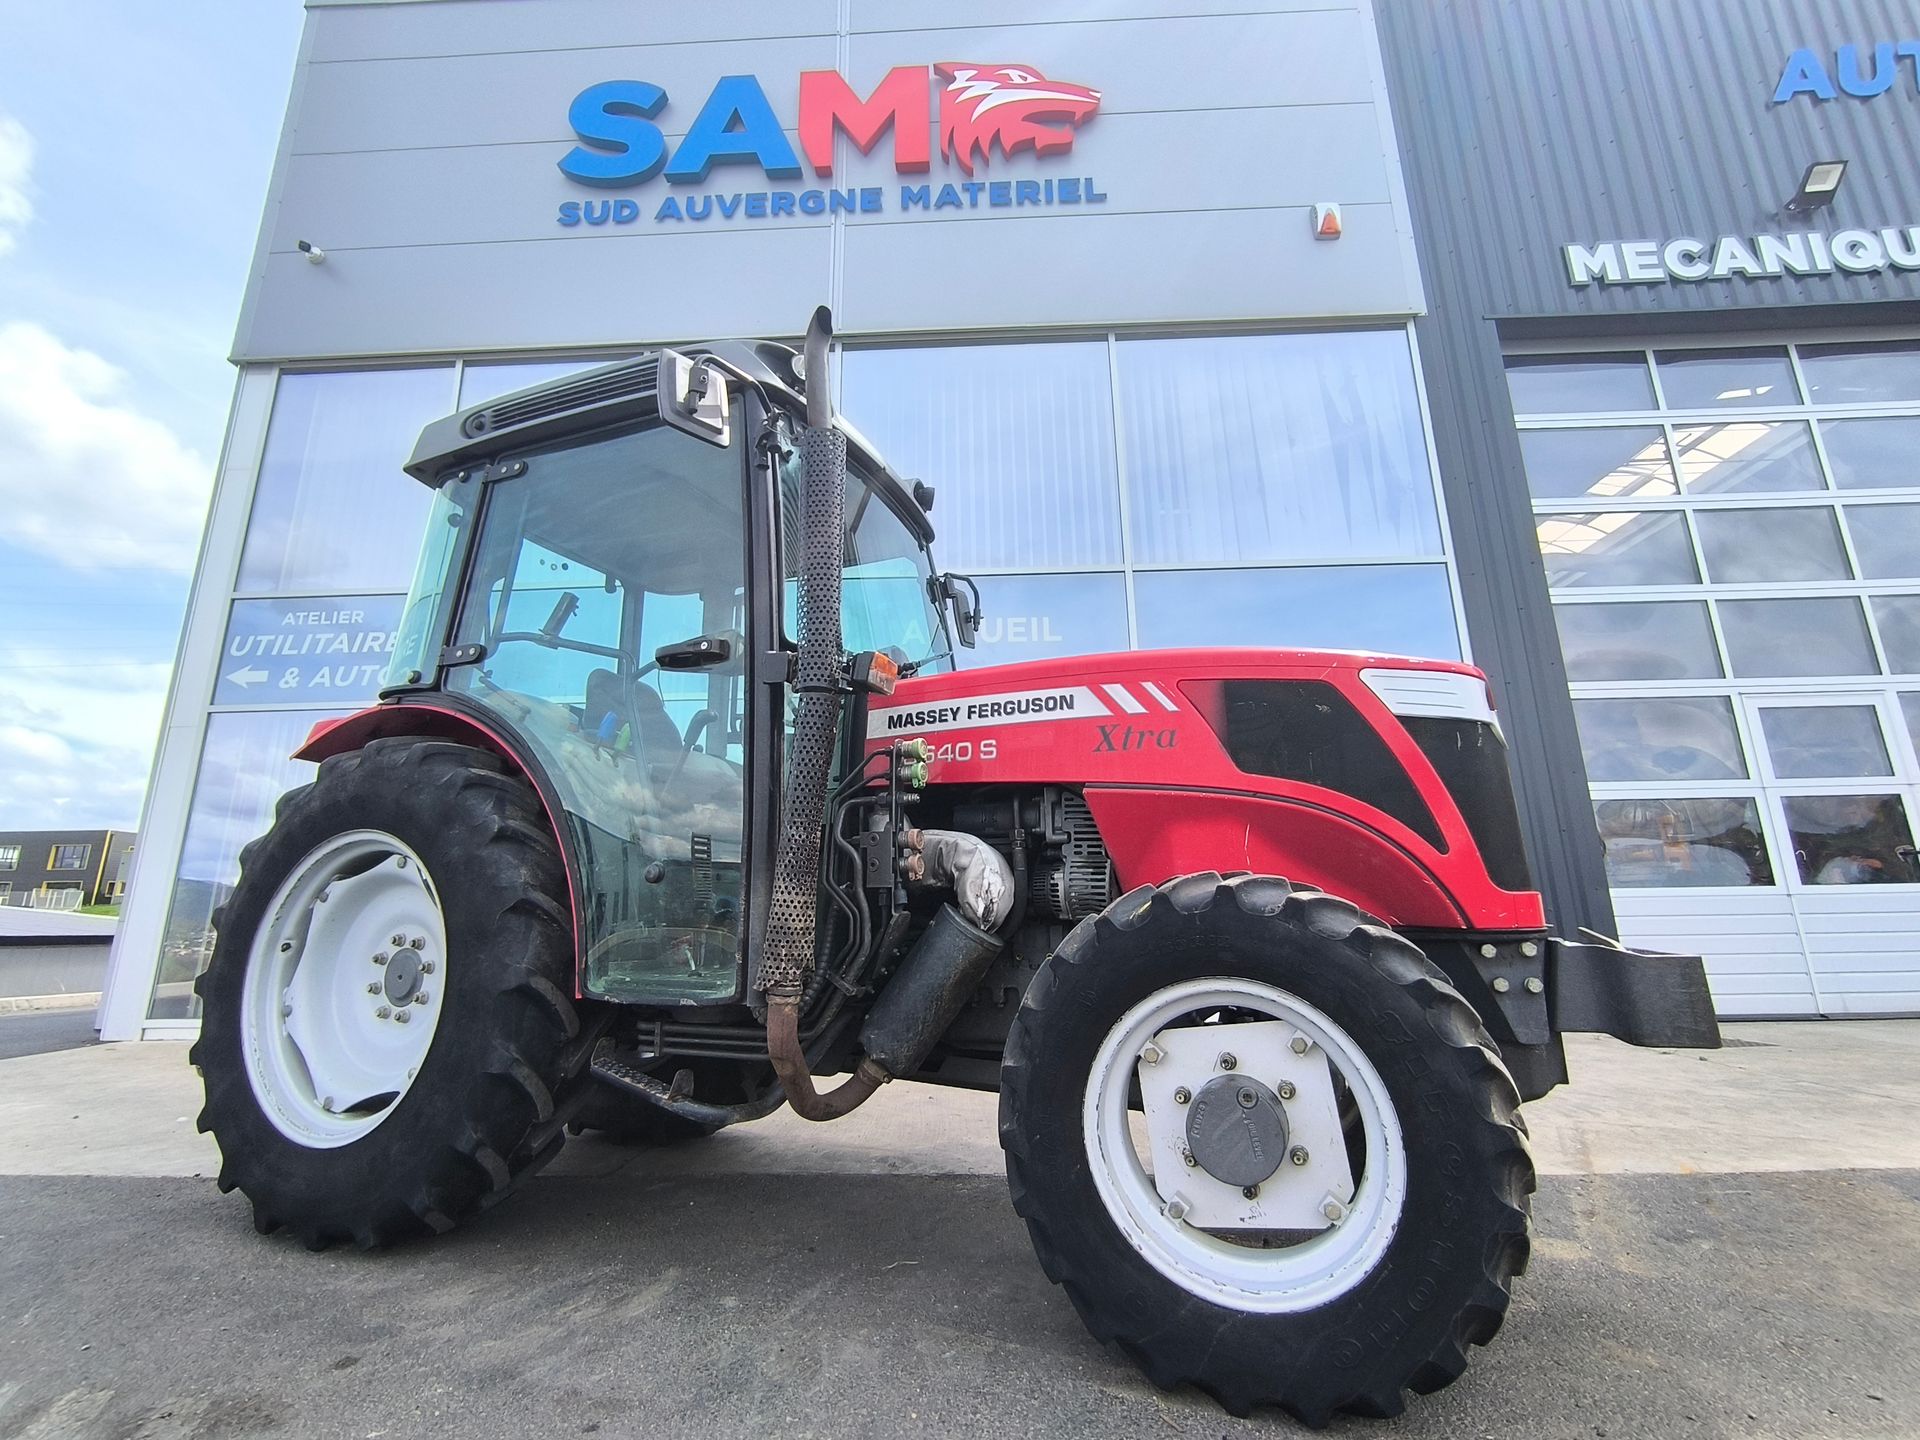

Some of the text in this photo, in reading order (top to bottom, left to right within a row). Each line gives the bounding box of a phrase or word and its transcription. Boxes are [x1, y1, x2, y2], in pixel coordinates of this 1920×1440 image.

[557, 65, 930, 188] SAM
[557, 177, 1108, 226] SUD AUVERGNE MATERIEL
[1564, 227, 1920, 284] MECANIQU
[281, 611, 364, 626] ATELIER
[902, 617, 1064, 645] AUEIL
[279, 666, 300, 689] &
[887, 694, 1075, 730] MASSEY FERGUSON
[903, 739, 997, 765] 640 S
[1092, 723, 1180, 752] Xtra
